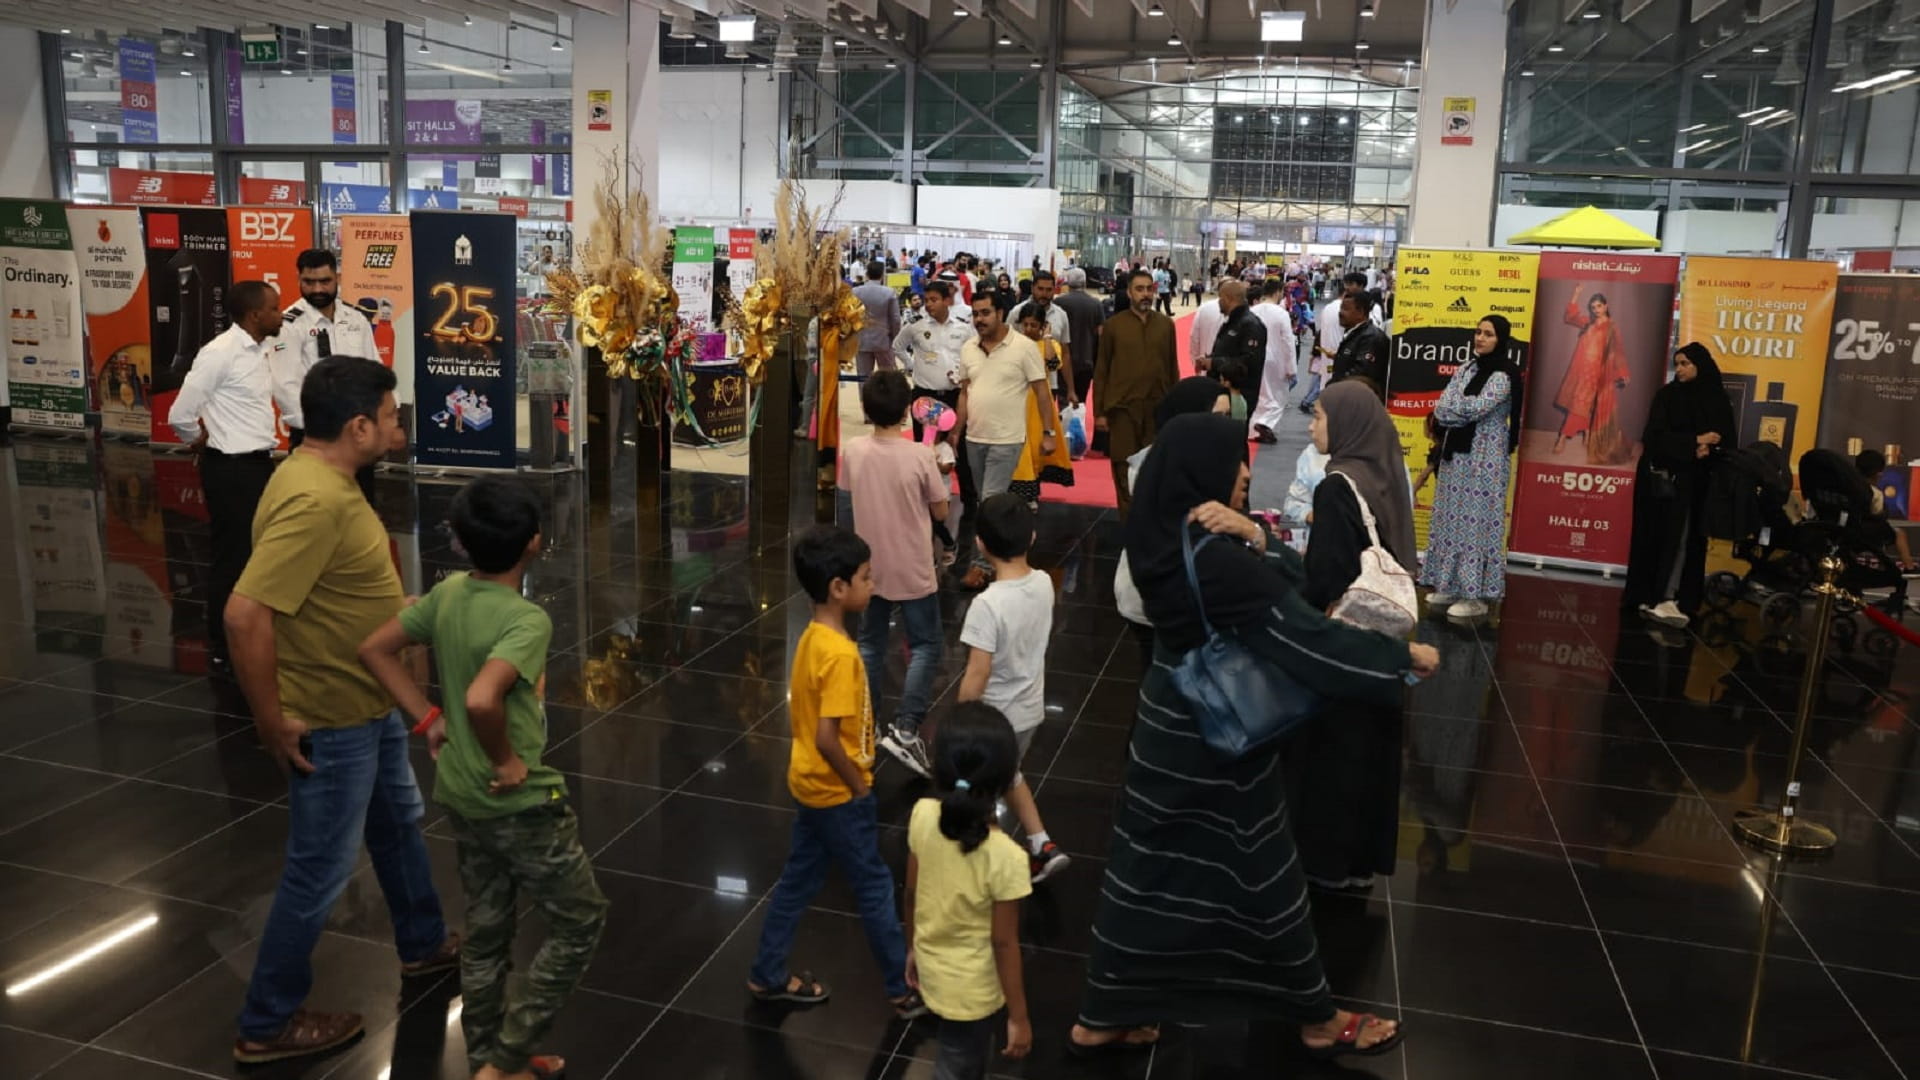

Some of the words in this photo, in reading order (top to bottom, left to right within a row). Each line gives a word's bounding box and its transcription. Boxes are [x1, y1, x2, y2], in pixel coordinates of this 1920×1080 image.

[424, 121, 456, 131] HALLS
[415, 133, 420, 142] 2
[432, 133, 438, 142] 4
[331, 201, 356, 211] adidas
[240, 212, 295, 242] BBZ
[355, 230, 404, 241] PERFUMES
[184, 242, 226, 251] TRIMMER
[3, 256, 19, 265] The
[364, 252, 394, 267] FREE
[1572, 260, 1606, 270] nishat
[1404, 266, 1430, 275] FILA
[1449, 268, 1481, 277] GUESS
[5, 267, 73, 288] Ordinary.
[1697, 280, 1751, 288] BELLISSIMO
[1715, 296, 1753, 309] Living
[1757, 298, 1808, 311] Legend
[430, 282, 495, 342] 25
[1717, 310, 1804, 334] TIGER
[1833, 318, 1896, 360] 25%
[1897, 339, 1912, 347] TO
[427, 365, 467, 376] VALUE
[469, 367, 501, 377] BACK
[1393, 400, 1425, 409] GREAT
[1537, 474, 1562, 484] FLAT
[1562, 471, 1617, 494] 50%
[1612, 477, 1633, 486] OFF
[1593, 520, 1609, 531] 03
